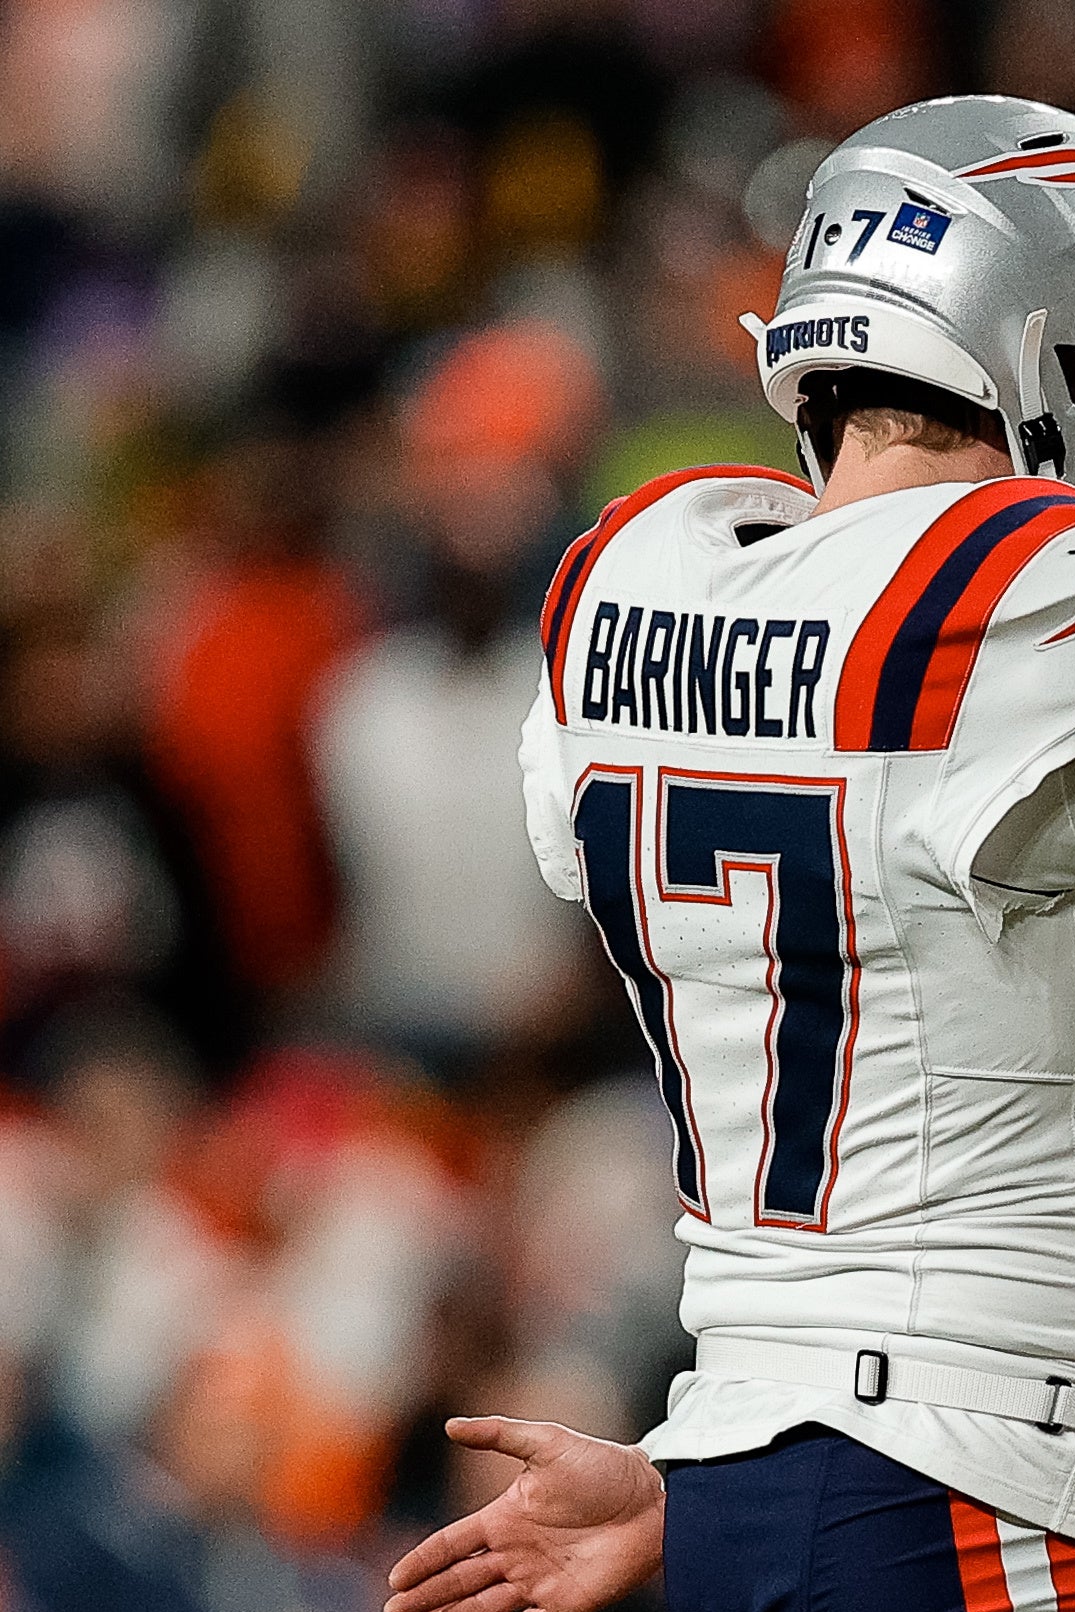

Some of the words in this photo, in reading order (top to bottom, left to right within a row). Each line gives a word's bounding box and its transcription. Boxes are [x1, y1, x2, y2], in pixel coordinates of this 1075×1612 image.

[892, 230, 936, 251] CHANGE
[766, 316, 870, 368] PATRIOTS
[582, 602, 831, 739] BARINGER
[573, 763, 860, 1234] 17
